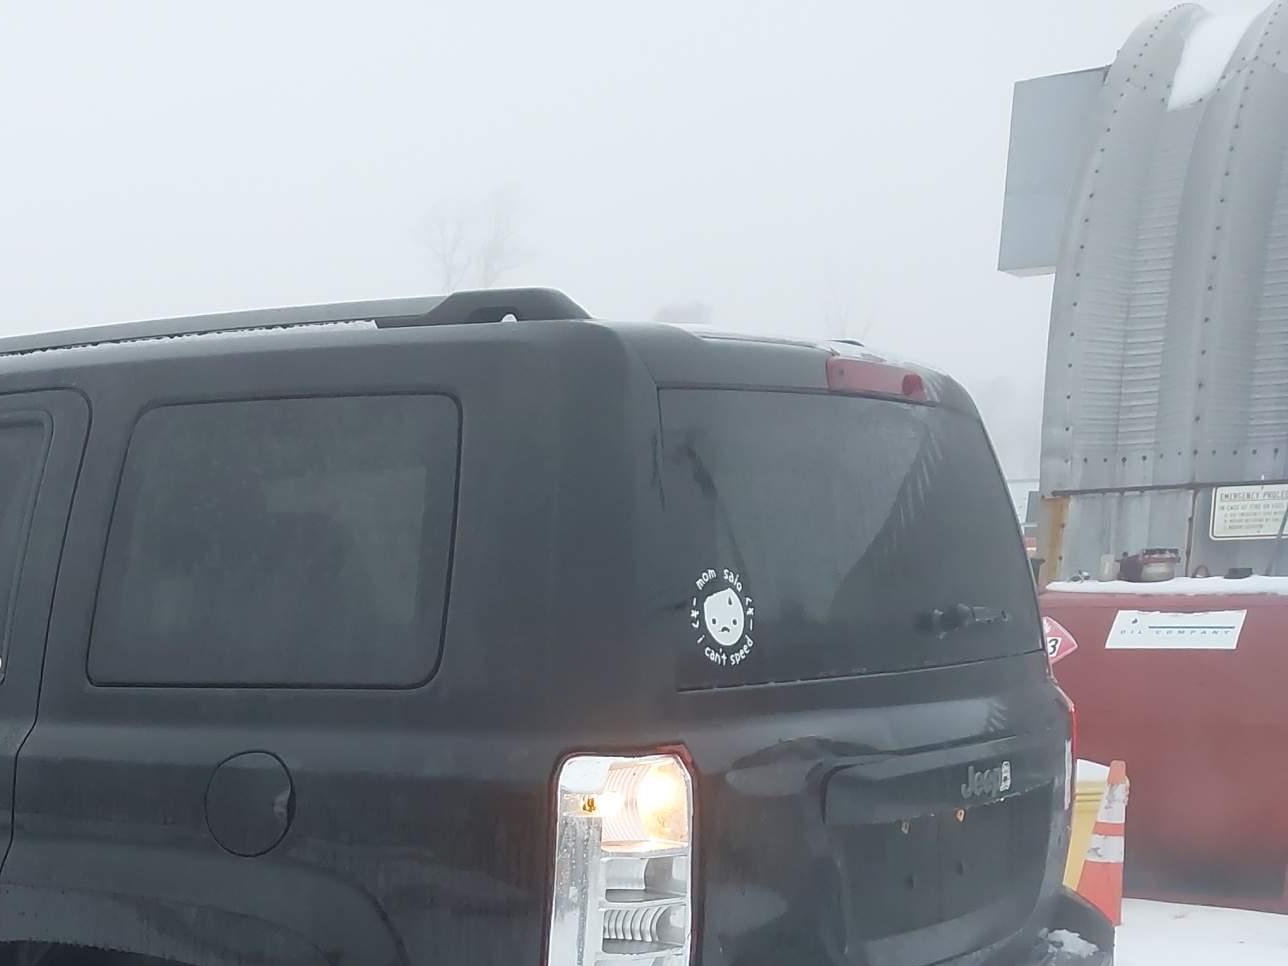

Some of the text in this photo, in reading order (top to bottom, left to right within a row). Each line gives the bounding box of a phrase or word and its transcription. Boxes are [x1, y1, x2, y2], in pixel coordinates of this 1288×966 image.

[695, 569, 717, 590] mom
[704, 646, 728, 666] can't
[730, 634, 754, 665] speed
[1048, 638, 1059, 656] 3
